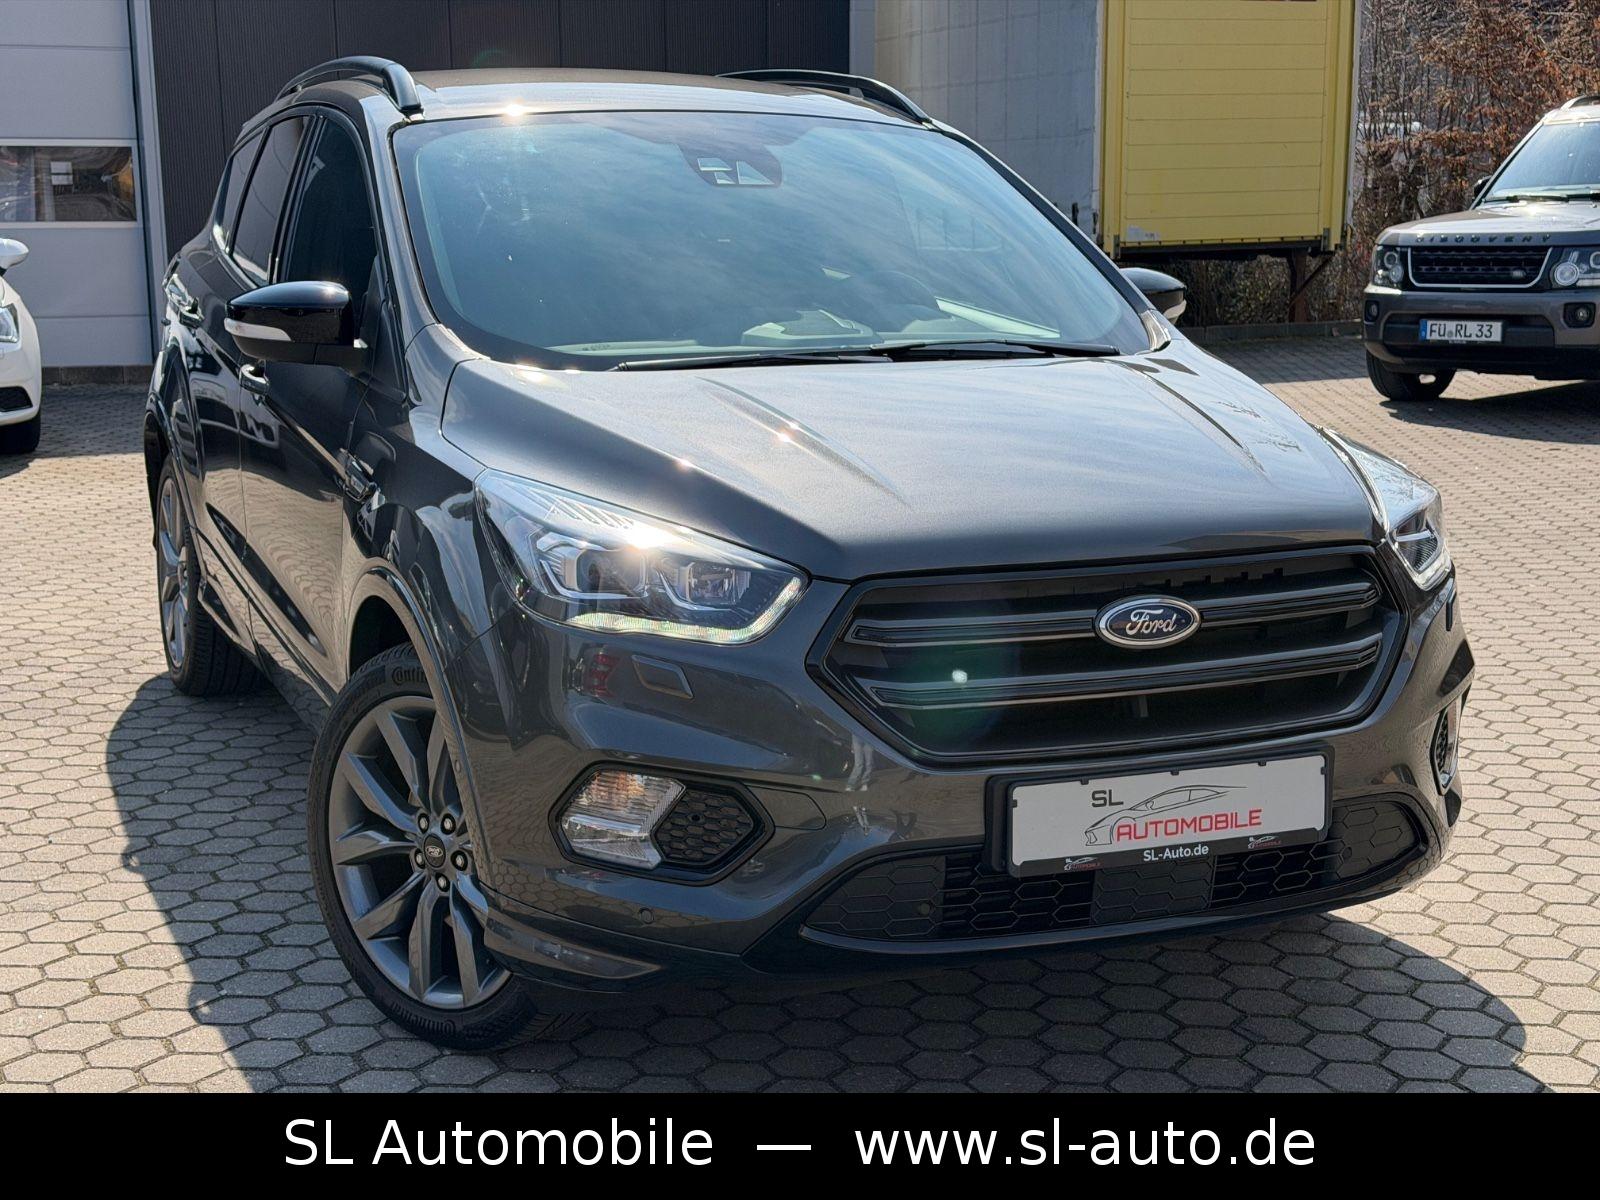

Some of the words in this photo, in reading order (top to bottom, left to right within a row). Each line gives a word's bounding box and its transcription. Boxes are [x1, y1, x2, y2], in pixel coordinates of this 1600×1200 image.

[1429, 323, 1446, 337] FÜ
[1455, 323, 1472, 338] RL
[1475, 324, 1493, 338] 33
[1125, 609, 1178, 635] Ford
[1091, 789, 1124, 808] SL
[1116, 808, 1263, 842] AUTOMOBILE
[1143, 844, 1209, 861] SL-Auto.de
